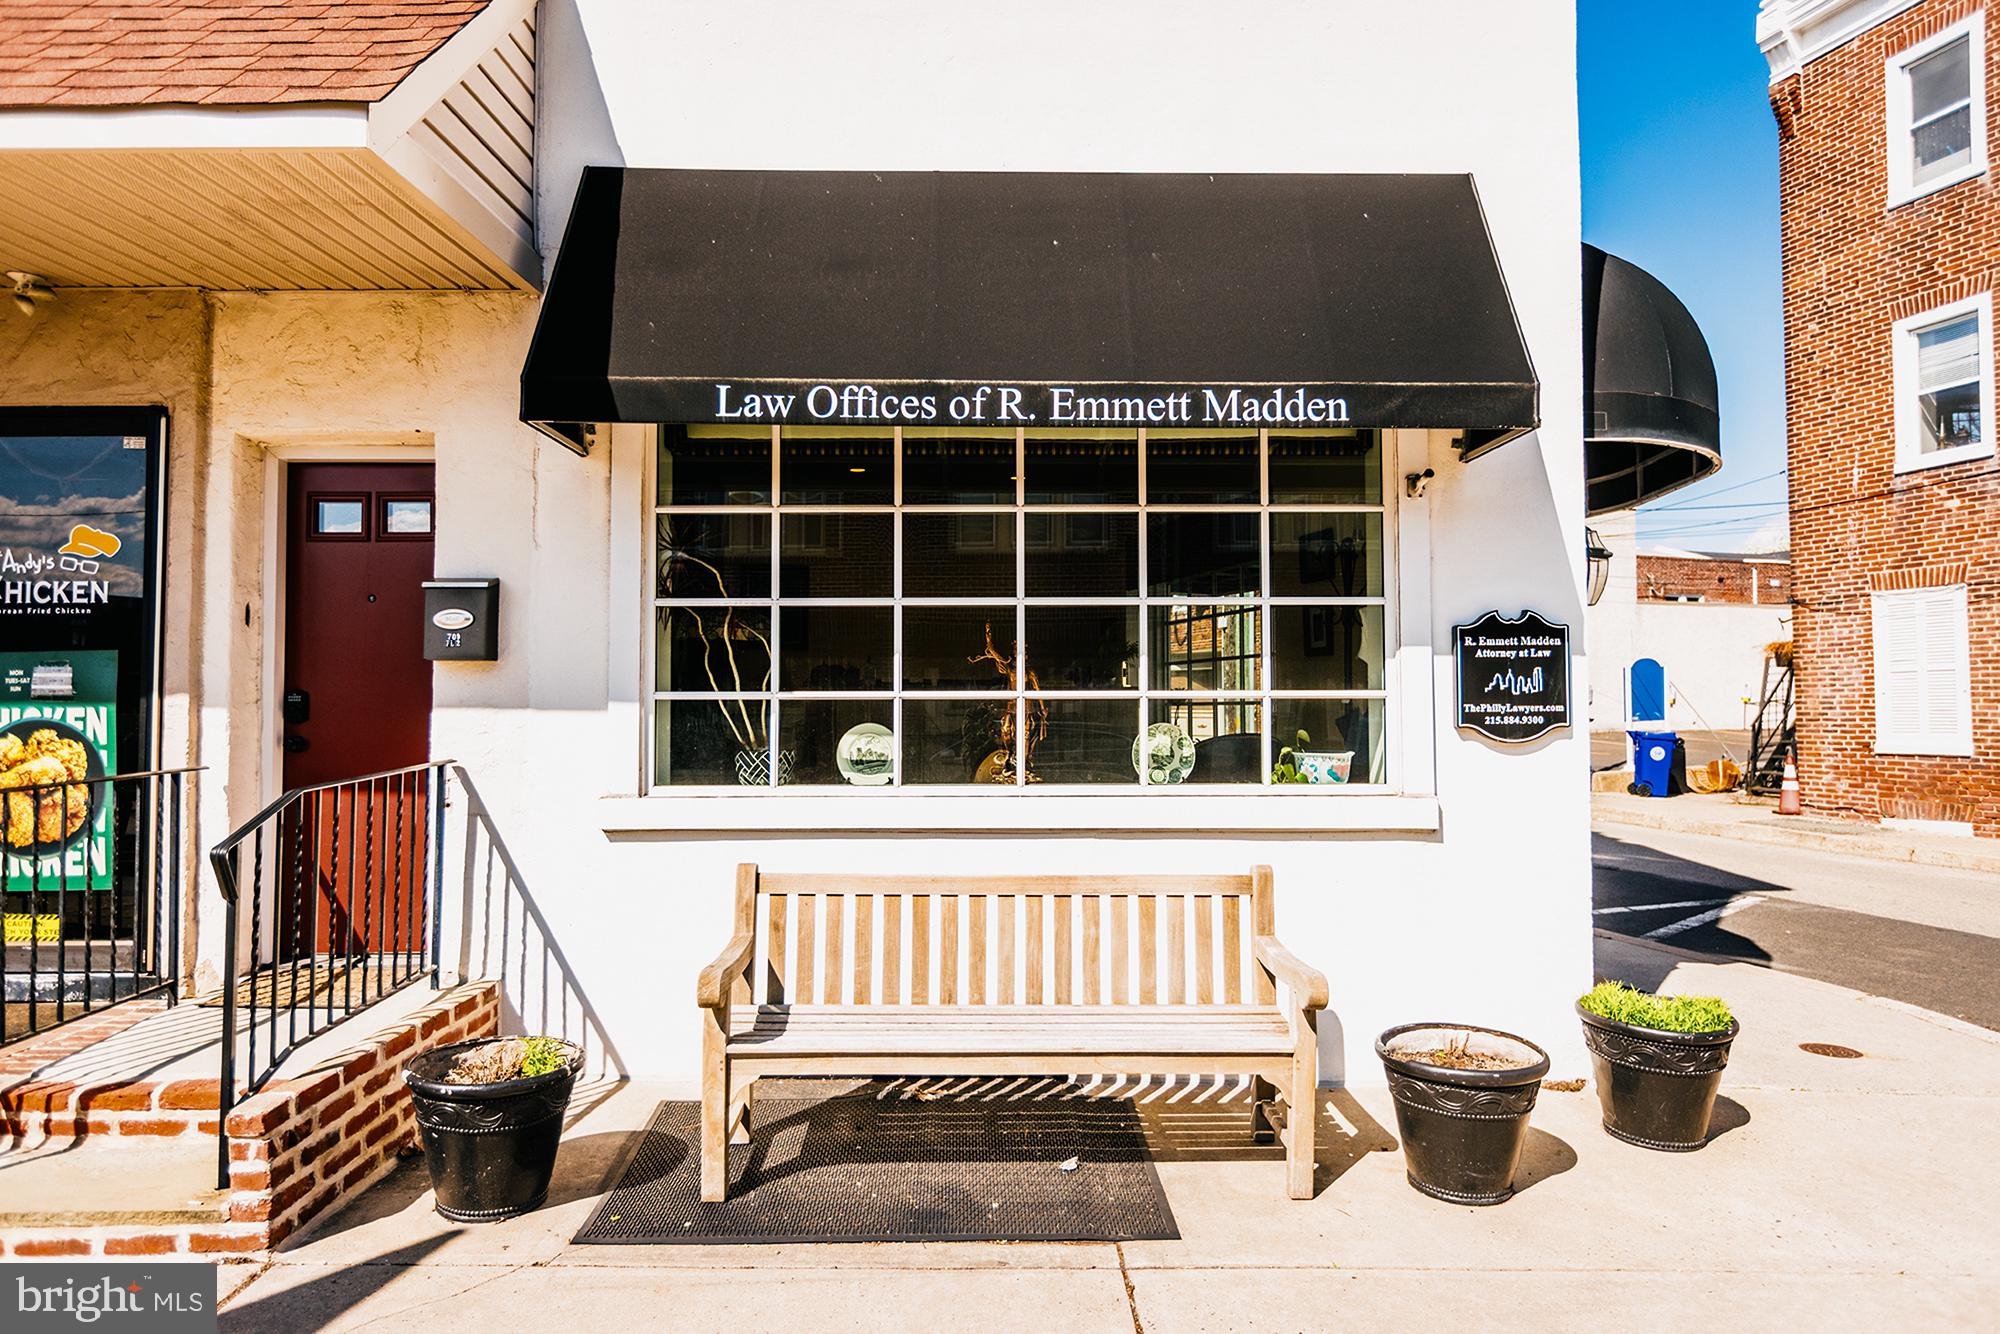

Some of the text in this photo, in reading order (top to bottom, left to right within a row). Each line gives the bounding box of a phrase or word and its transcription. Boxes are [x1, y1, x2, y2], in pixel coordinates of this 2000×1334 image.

[715, 384, 1350, 422] Law Offices of R. Emmett Madden
[2, 548, 55, 574] Andy's
[0, 580, 109, 604] HICKEN
[27, 607, 51, 615] Fried
[55, 607, 92, 615] Chicken
[1464, 636, 1562, 646] R. Emmett Madden
[1474, 648, 1552, 660] Attorney at Law
[1463, 704, 1565, 714] ThePhillyLawyers.com
